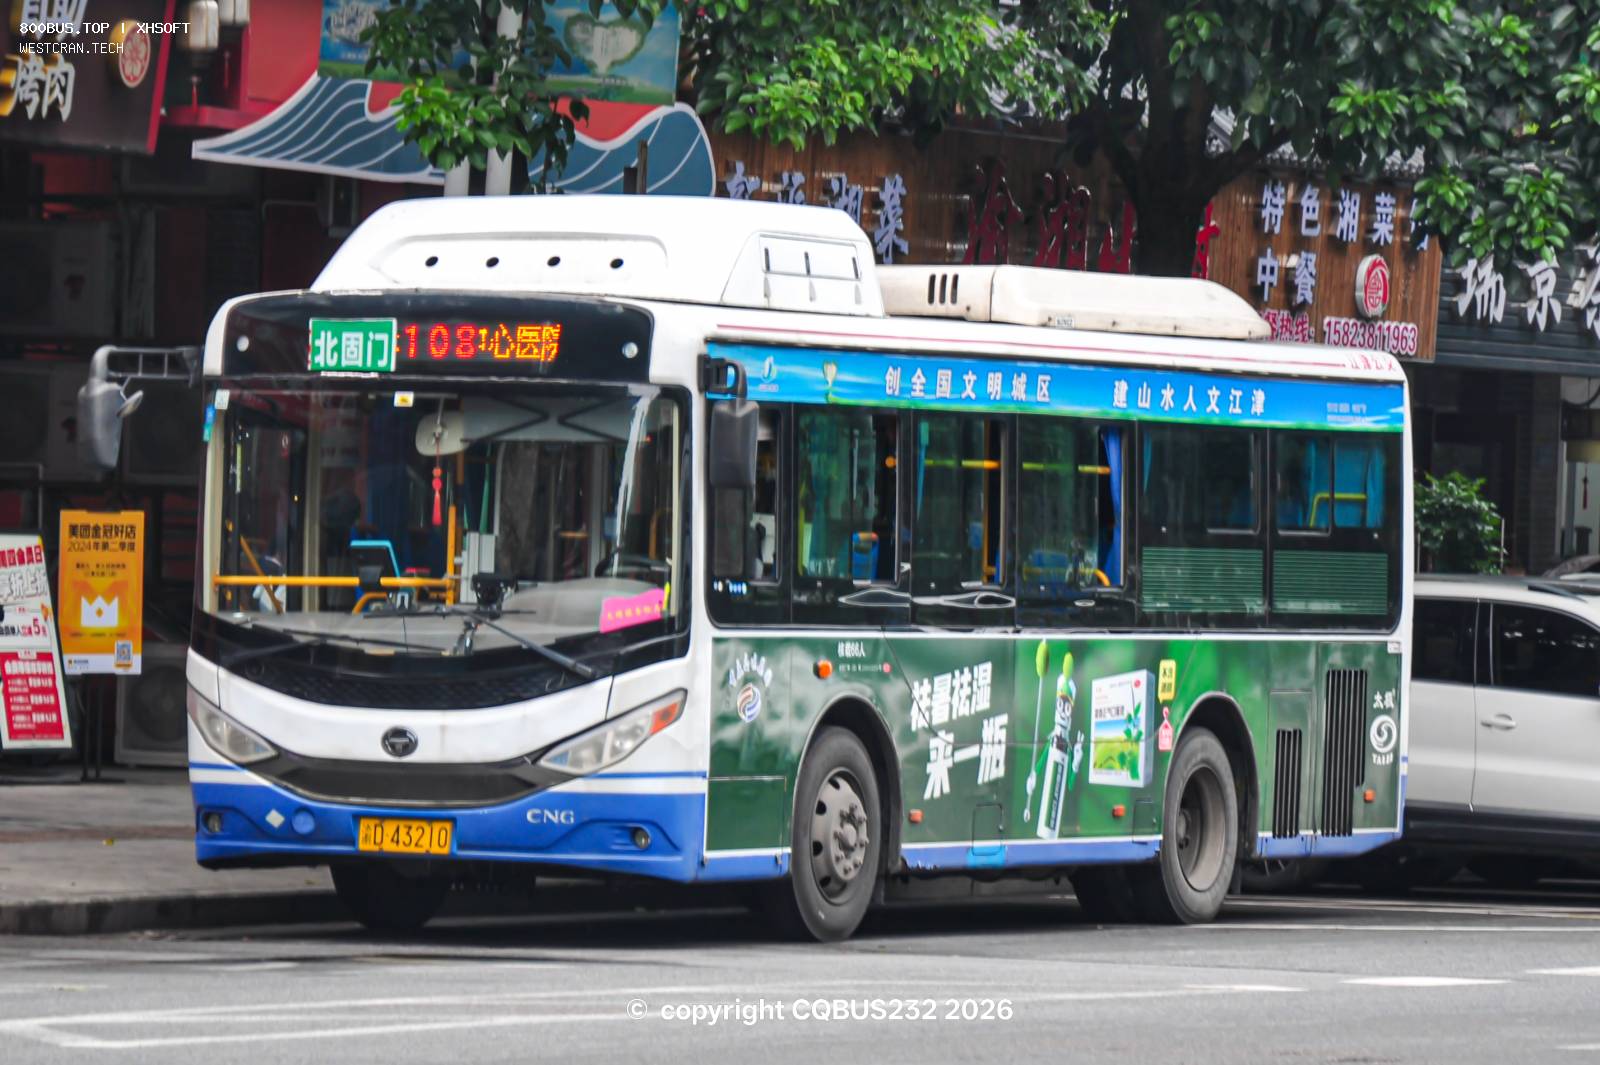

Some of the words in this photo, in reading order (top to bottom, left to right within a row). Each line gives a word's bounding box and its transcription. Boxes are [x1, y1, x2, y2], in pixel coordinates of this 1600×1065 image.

[1257, 247, 1317, 305] 中餐
[314, 330, 389, 368] 北固门
[404, 323, 477, 360] 108
[1324, 316, 1418, 356] 15823811963
[885, 366, 1051, 402] 创全国文明城区
[1112, 380, 1266, 416] 建山水人文江津
[923, 712, 1009, 801] 来一瓶
[526, 808, 575, 825] CNG
